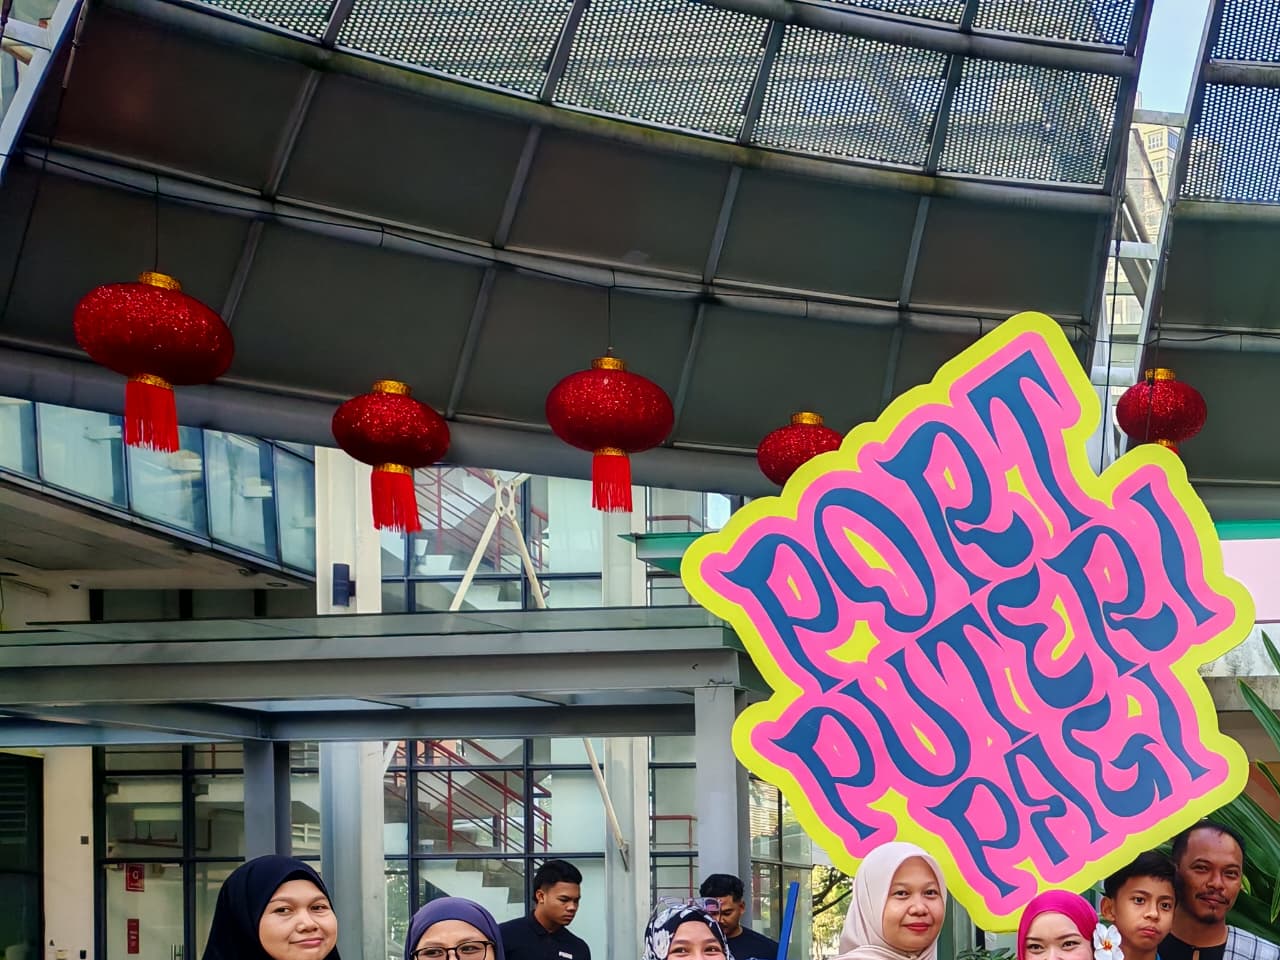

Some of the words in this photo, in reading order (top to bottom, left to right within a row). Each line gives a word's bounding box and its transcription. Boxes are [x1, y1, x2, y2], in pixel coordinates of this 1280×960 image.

[720, 349, 1094, 694] PORT
[769, 482, 1216, 841] PUTERI
[924, 664, 1211, 898] PAGI
